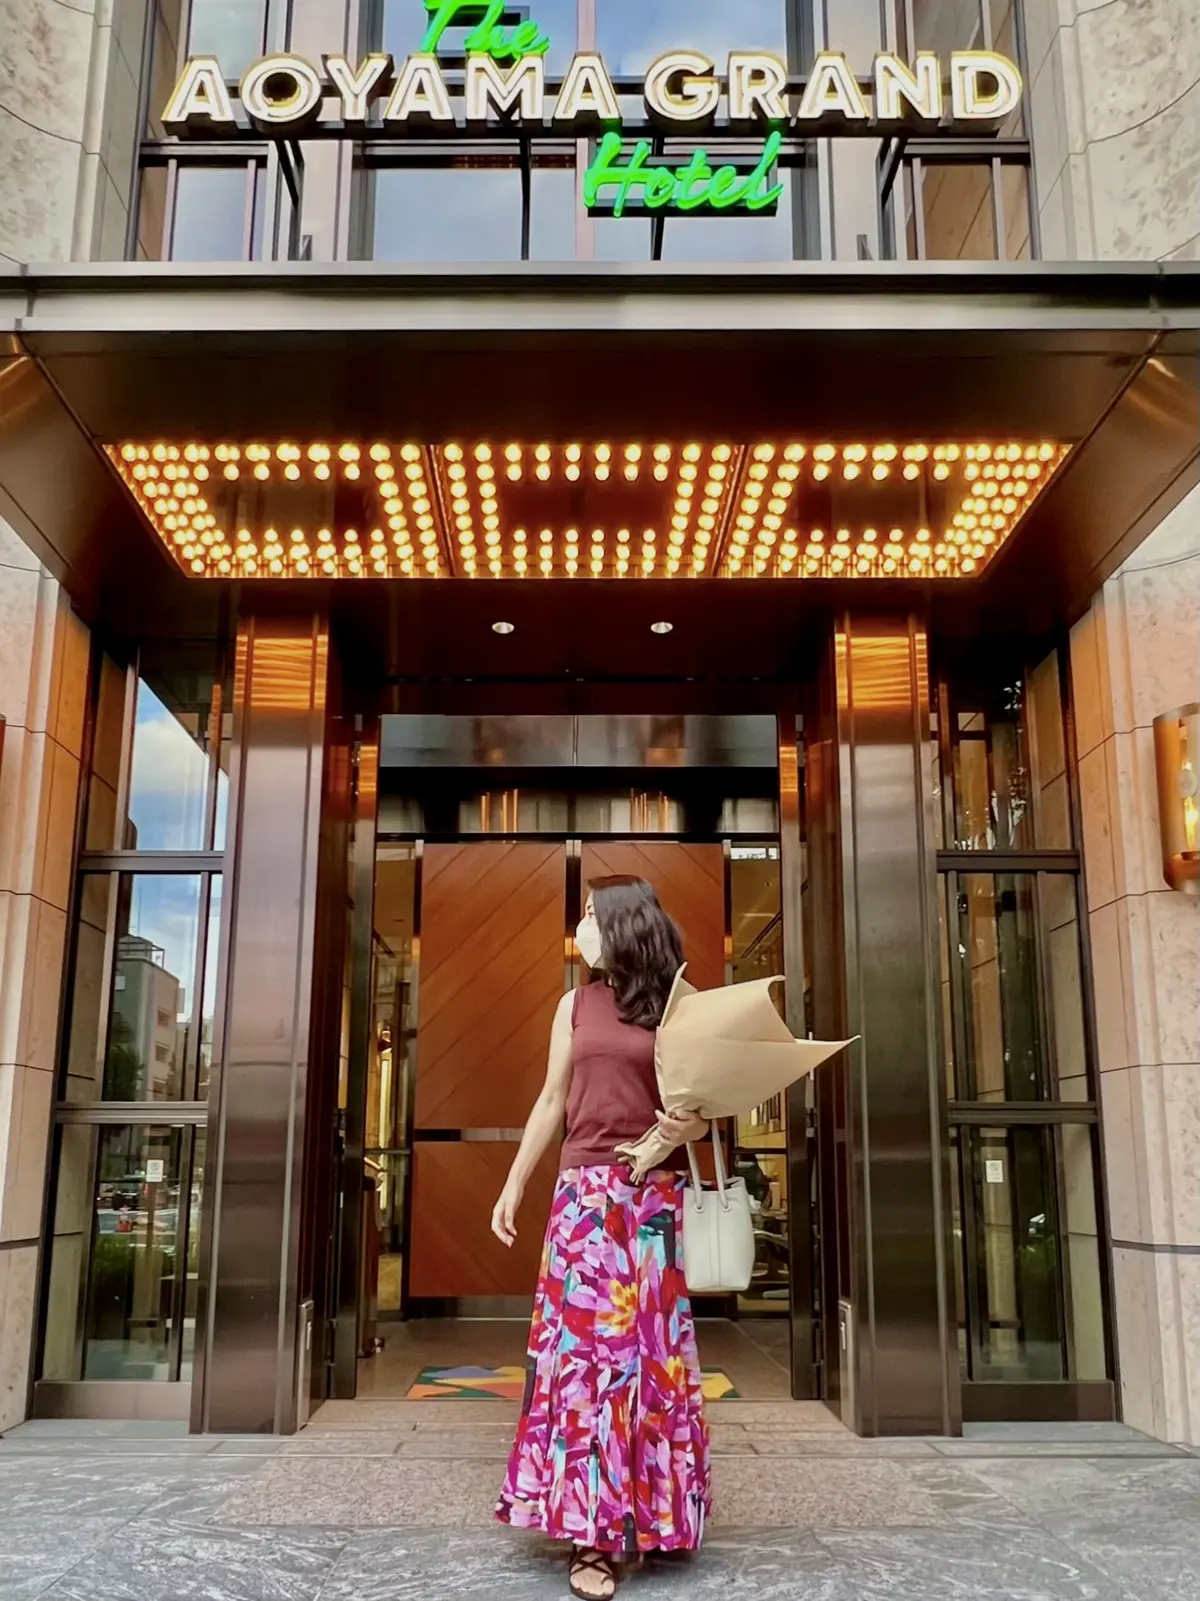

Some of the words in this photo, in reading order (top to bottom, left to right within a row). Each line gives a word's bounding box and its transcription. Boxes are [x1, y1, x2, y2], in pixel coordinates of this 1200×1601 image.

[421, 0, 550, 59] The
[161, 53, 624, 123] AOYAMA
[643, 51, 1023, 121] GRAND
[583, 130, 785, 218] Hotel
